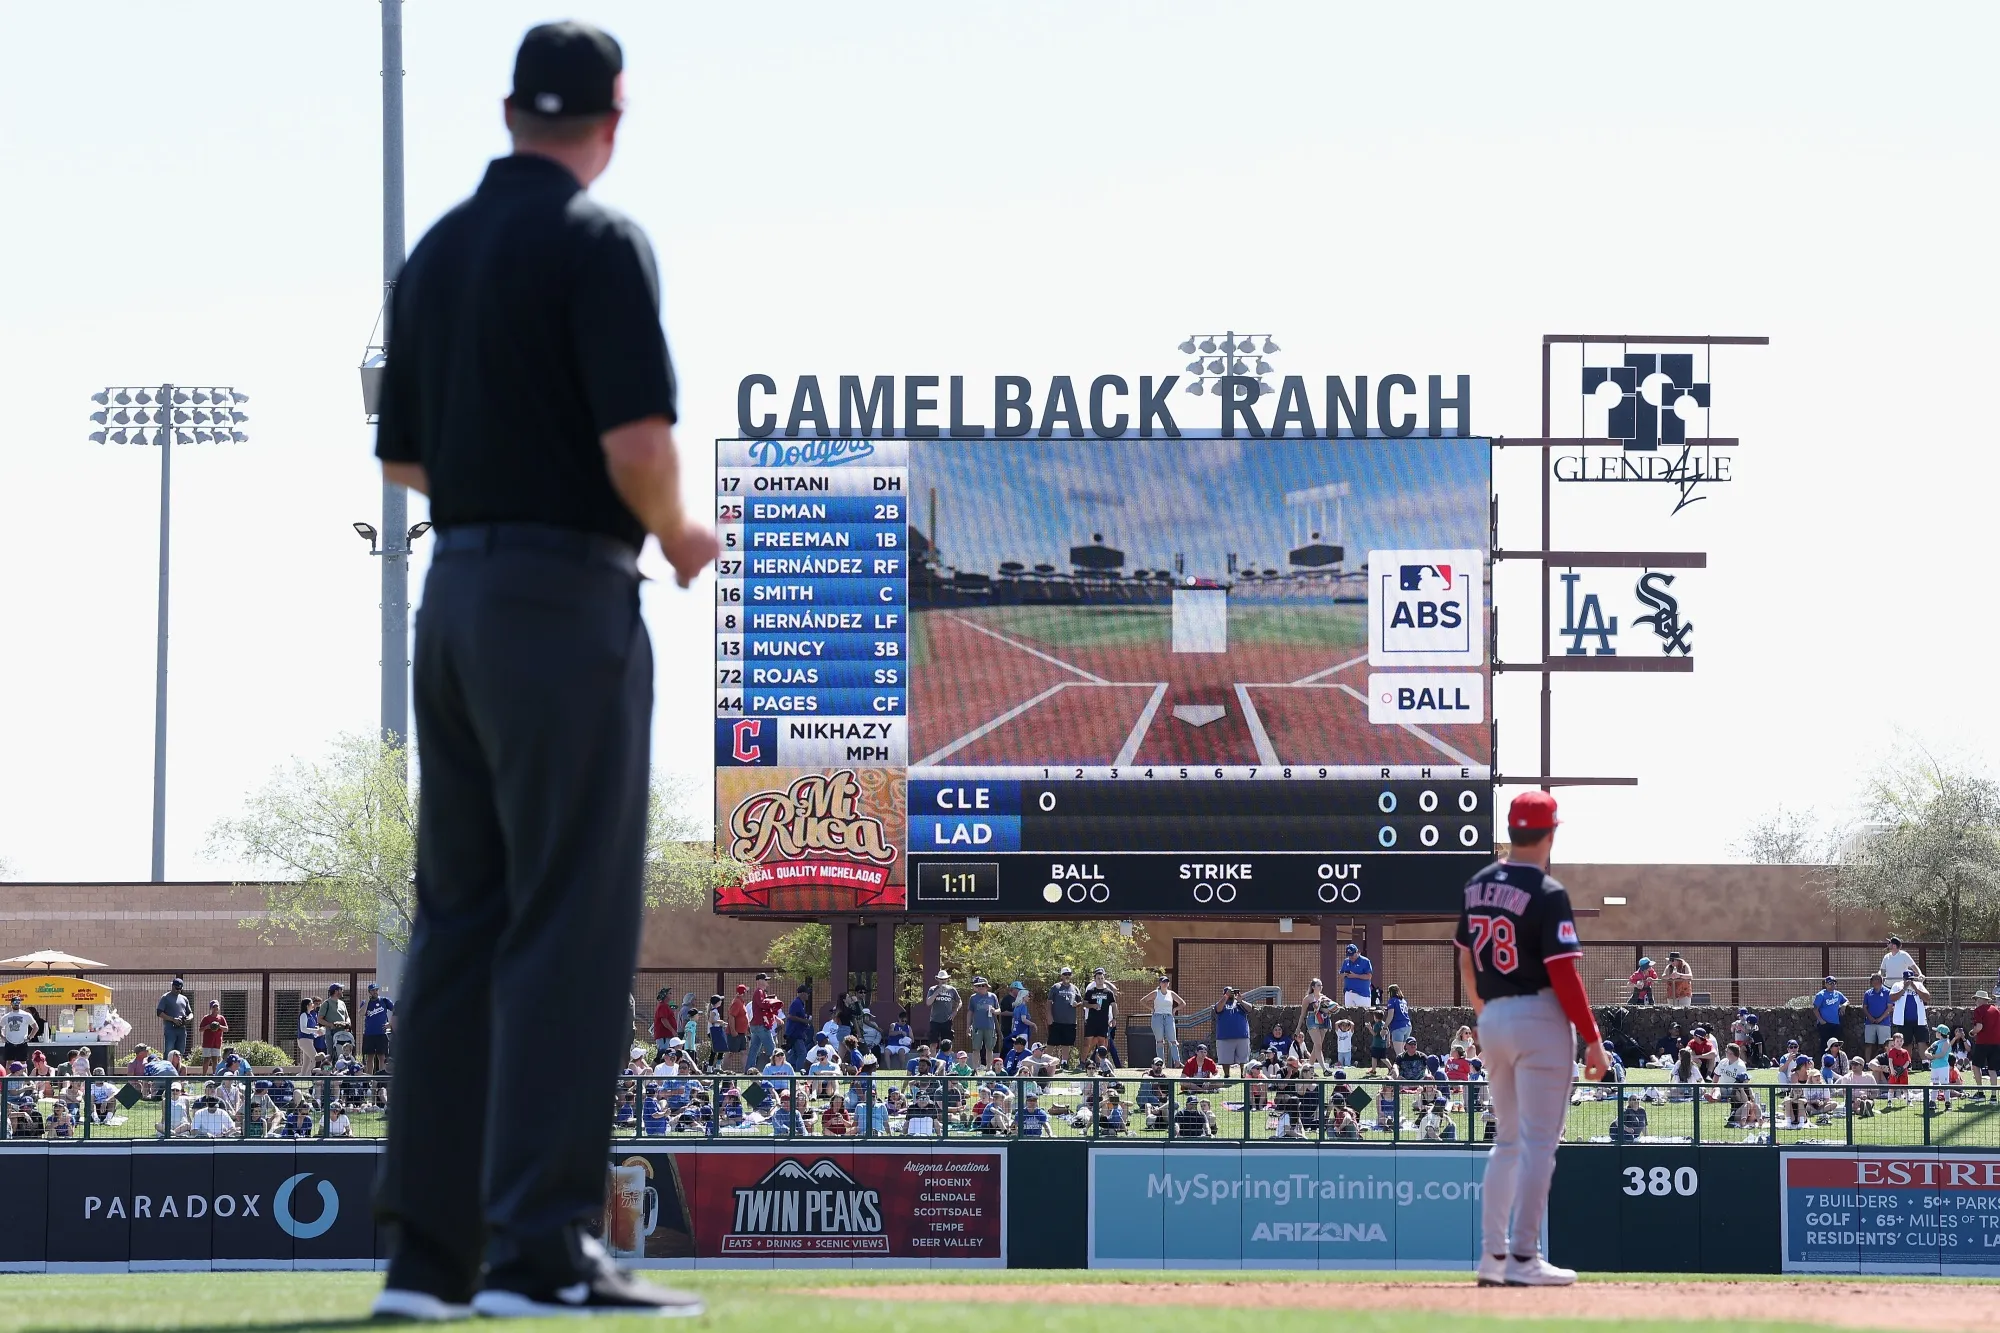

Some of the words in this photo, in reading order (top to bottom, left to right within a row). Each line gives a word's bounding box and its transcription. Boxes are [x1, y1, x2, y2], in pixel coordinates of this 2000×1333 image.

[737, 374, 1182, 438] CAMELBACK
[1221, 374, 1471, 438] RANCH
[1553, 445, 1732, 484] GLENDALE
[720, 477, 741, 492] 17
[753, 476, 830, 492] OHTANI
[873, 476, 901, 492] DH
[719, 504, 742, 519] 25
[753, 503, 827, 519] EDMAN
[874, 503, 899, 519] 2B
[725, 533, 737, 547] 5
[753, 532, 850, 548] FREEMAN
[876, 532, 897, 548] 1B
[719, 560, 742, 575] 37
[753, 556, 862, 574] HERNÁNDEZ
[874, 560, 899, 575] RF
[720, 587, 741, 602] 16
[753, 585, 814, 601] SMITH
[879, 586, 893, 601] C
[725, 614, 737, 629] 8
[753, 610, 862, 629] HERNÁNDEZ
[874, 614, 898, 629] LF
[1390, 600, 1462, 629] ABS
[1559, 573, 1618, 657] LA
[1631, 571, 1694, 656] Sox
[720, 641, 741, 656] 13
[753, 640, 826, 656] MUNCY
[874, 641, 899, 657] 3B
[719, 669, 742, 684] 72
[753, 667, 819, 684] ROJAS
[874, 668, 898, 684] SS
[717, 696, 743, 712] 44
[753, 695, 818, 712] PAGES
[873, 695, 899, 712] CF
[1398, 687, 1470, 710] BALL
[789, 722, 893, 740] NIKHAZY
[732, 719, 762, 763] C
[846, 746, 889, 761] MPH
[1043, 768, 1049, 779] 1
[1075, 768, 1084, 779] 2
[1110, 768, 1118, 779] 3
[1144, 768, 1153, 779] 4
[1179, 768, 1188, 779] 5
[1214, 768, 1223, 779] 6
[1249, 768, 1257, 779] 7
[1283, 768, 1292, 779] 8
[1318, 768, 1327, 779] 9
[1381, 768, 1391, 779] R
[1422, 768, 1431, 779] H
[1461, 768, 1470, 779] E
[787, 769, 863, 821] Mi
[936, 787, 990, 809] CLE
[1039, 791, 1056, 812] 0
[1377, 790, 1397, 813] 0
[1418, 790, 1438, 813] 0
[1458, 790, 1478, 813] 0
[730, 790, 898, 865] Ruca
[934, 823, 992, 845] LAD
[1378, 825, 1397, 848] 0
[1419, 824, 1439, 847] 0
[1459, 824, 1479, 847] 0
[776, 865, 818, 880] QUALITY
[819, 865, 882, 885] MICHELADAS
[1051, 863, 1105, 880] BALL
[1179, 863, 1253, 880] STRIKE
[1317, 863, 1362, 880] OUT
[941, 873, 976, 893] 1:11
[1467, 914, 1519, 975] 78
[904, 1160, 943, 1176] Arizona
[944, 1160, 991, 1173] Locations
[924, 1178, 972, 1188] PHOENIX
[1147, 1173, 1484, 1206] MySpringTraining.com
[1622, 1165, 1699, 1197] 380
[919, 1193, 976, 1202] GLENDALE
[1805, 1194, 1815, 1208] 7
[1819, 1194, 1898, 1209] BUILDERS
[1956, 1196, 2000, 1210] PARK
[84, 1194, 261, 1220] PARADOX
[734, 1190, 799, 1233] TWIN
[805, 1190, 882, 1233] PEAKS
[913, 1207, 982, 1217] SCOTTSDALE
[928, 1222, 965, 1232] TEMPE
[1805, 1212, 1850, 1226] GOLF
[1876, 1214, 1904, 1227] 65+
[1909, 1214, 1958, 1228] MILES
[1961, 1215, 1975, 1224] OF
[1250, 1222, 1388, 1242] ARIZONA
[1806, 1231, 1901, 1246] RESIDENTS'
[1905, 1232, 1958, 1247] CLUBS
[728, 1239, 753, 1249] EATS
[766, 1239, 802, 1249] DRINKS
[815, 1239, 850, 1249] SCENIC
[852, 1239, 884, 1249] VIEWS
[912, 1237, 941, 1248] DEER
[944, 1237, 984, 1248] VALLEY
